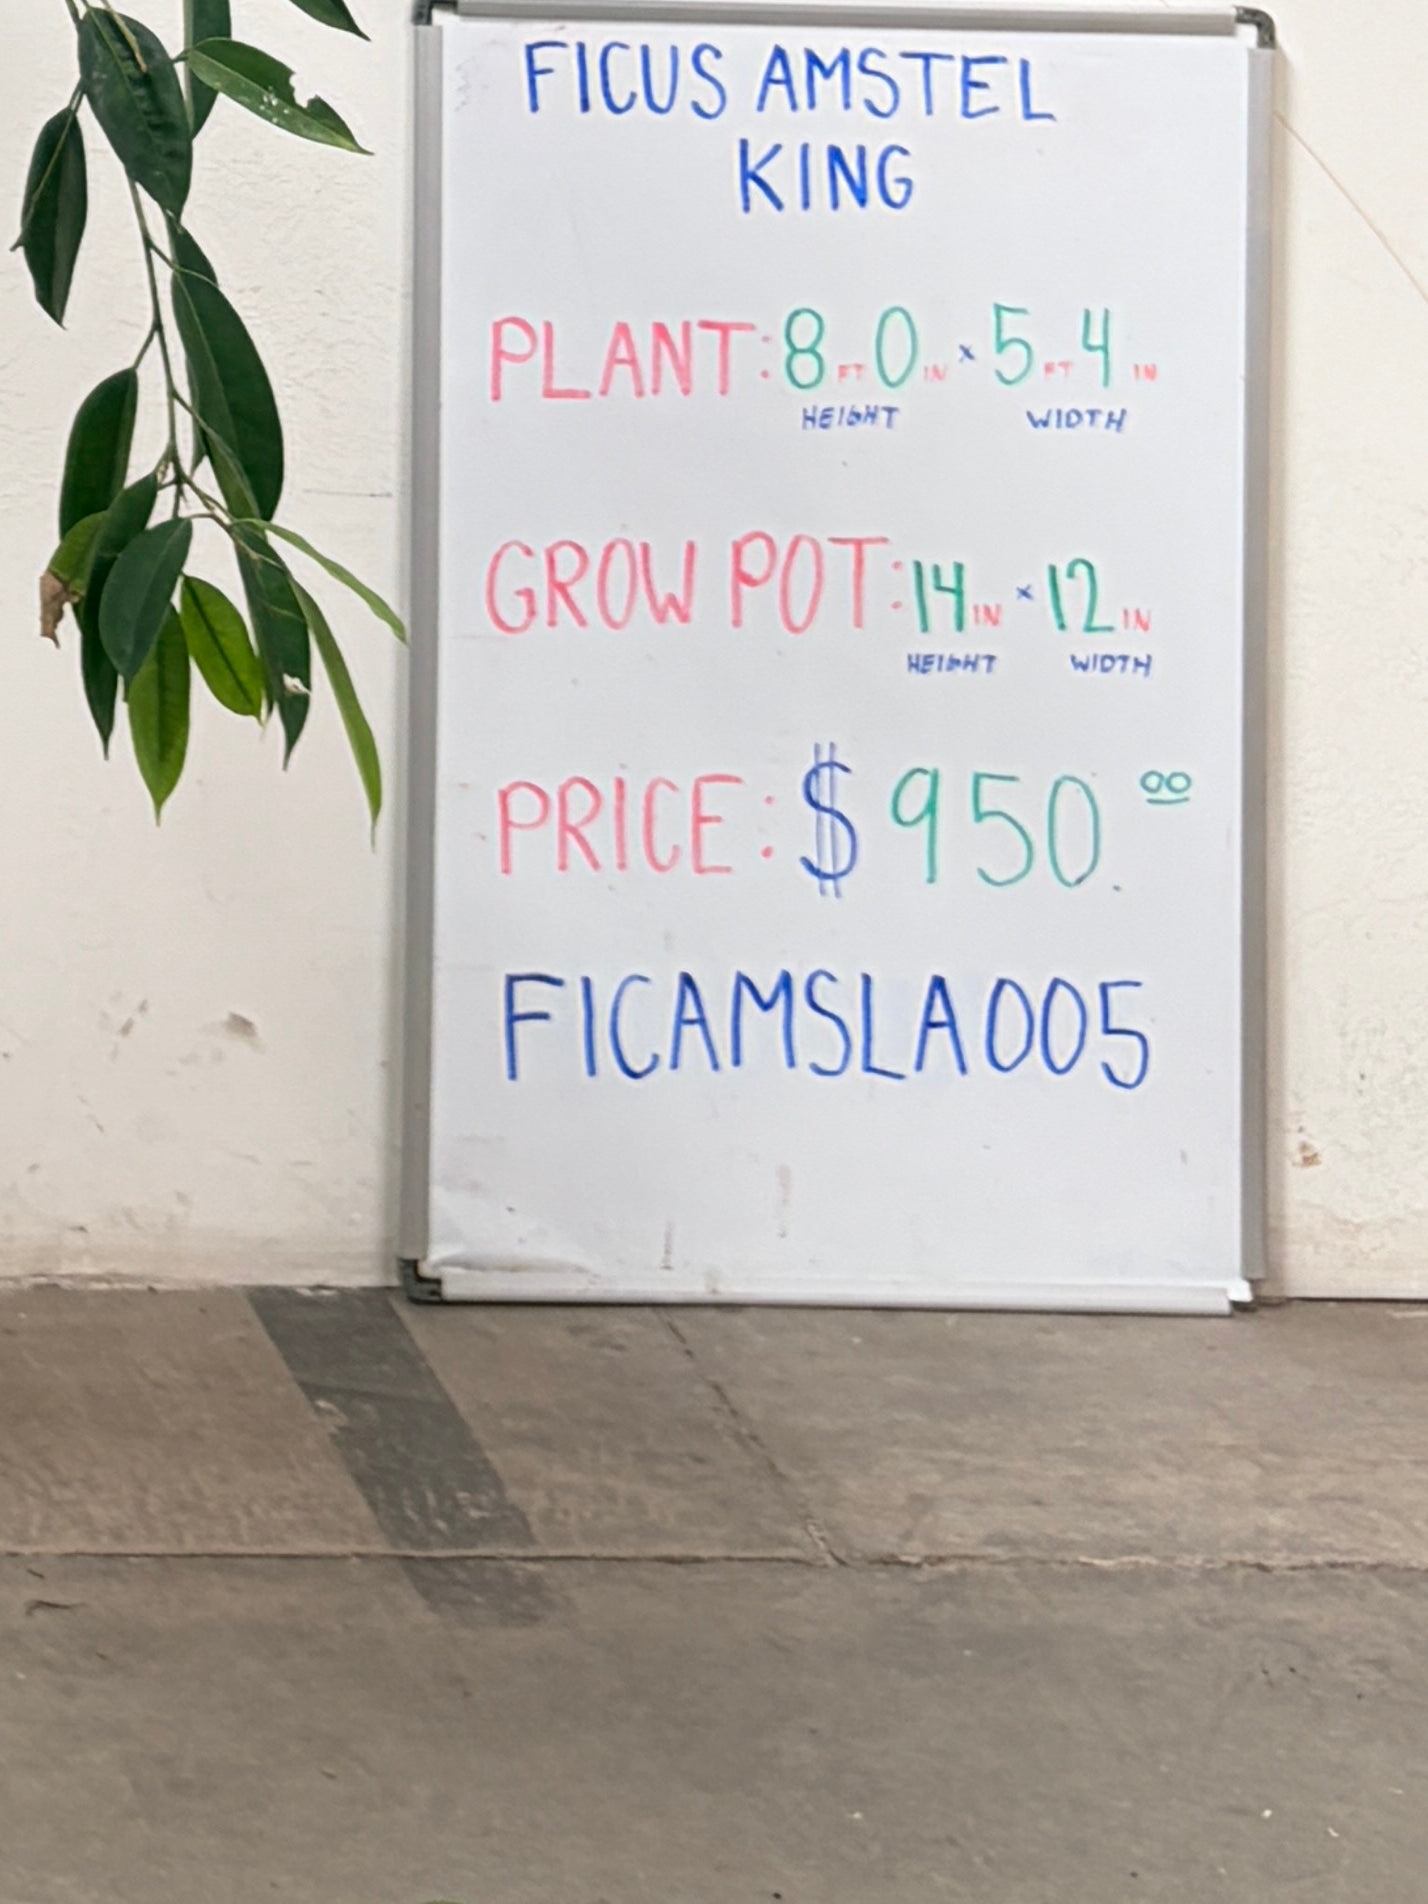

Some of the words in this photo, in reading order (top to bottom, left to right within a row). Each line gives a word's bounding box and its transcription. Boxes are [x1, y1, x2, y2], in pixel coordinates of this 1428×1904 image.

[524, 40, 728, 121] FICUS
[756, 45, 1058, 123] AMSTEL
[738, 137, 915, 214] KING
[490, 316, 771, 403] PLANT:
[801, 404, 900, 431] HEIGHT
[1026, 407, 1127, 433] WIDTH
[485, 539, 697, 635] GROW
[730, 530, 905, 634] POT:
[907, 652, 997, 675] HEIGHT
[1070, 653, 1153, 677] WIDTH
[497, 772, 776, 876] PRICE:
[504, 969, 1150, 1091] FICAMSLA005
